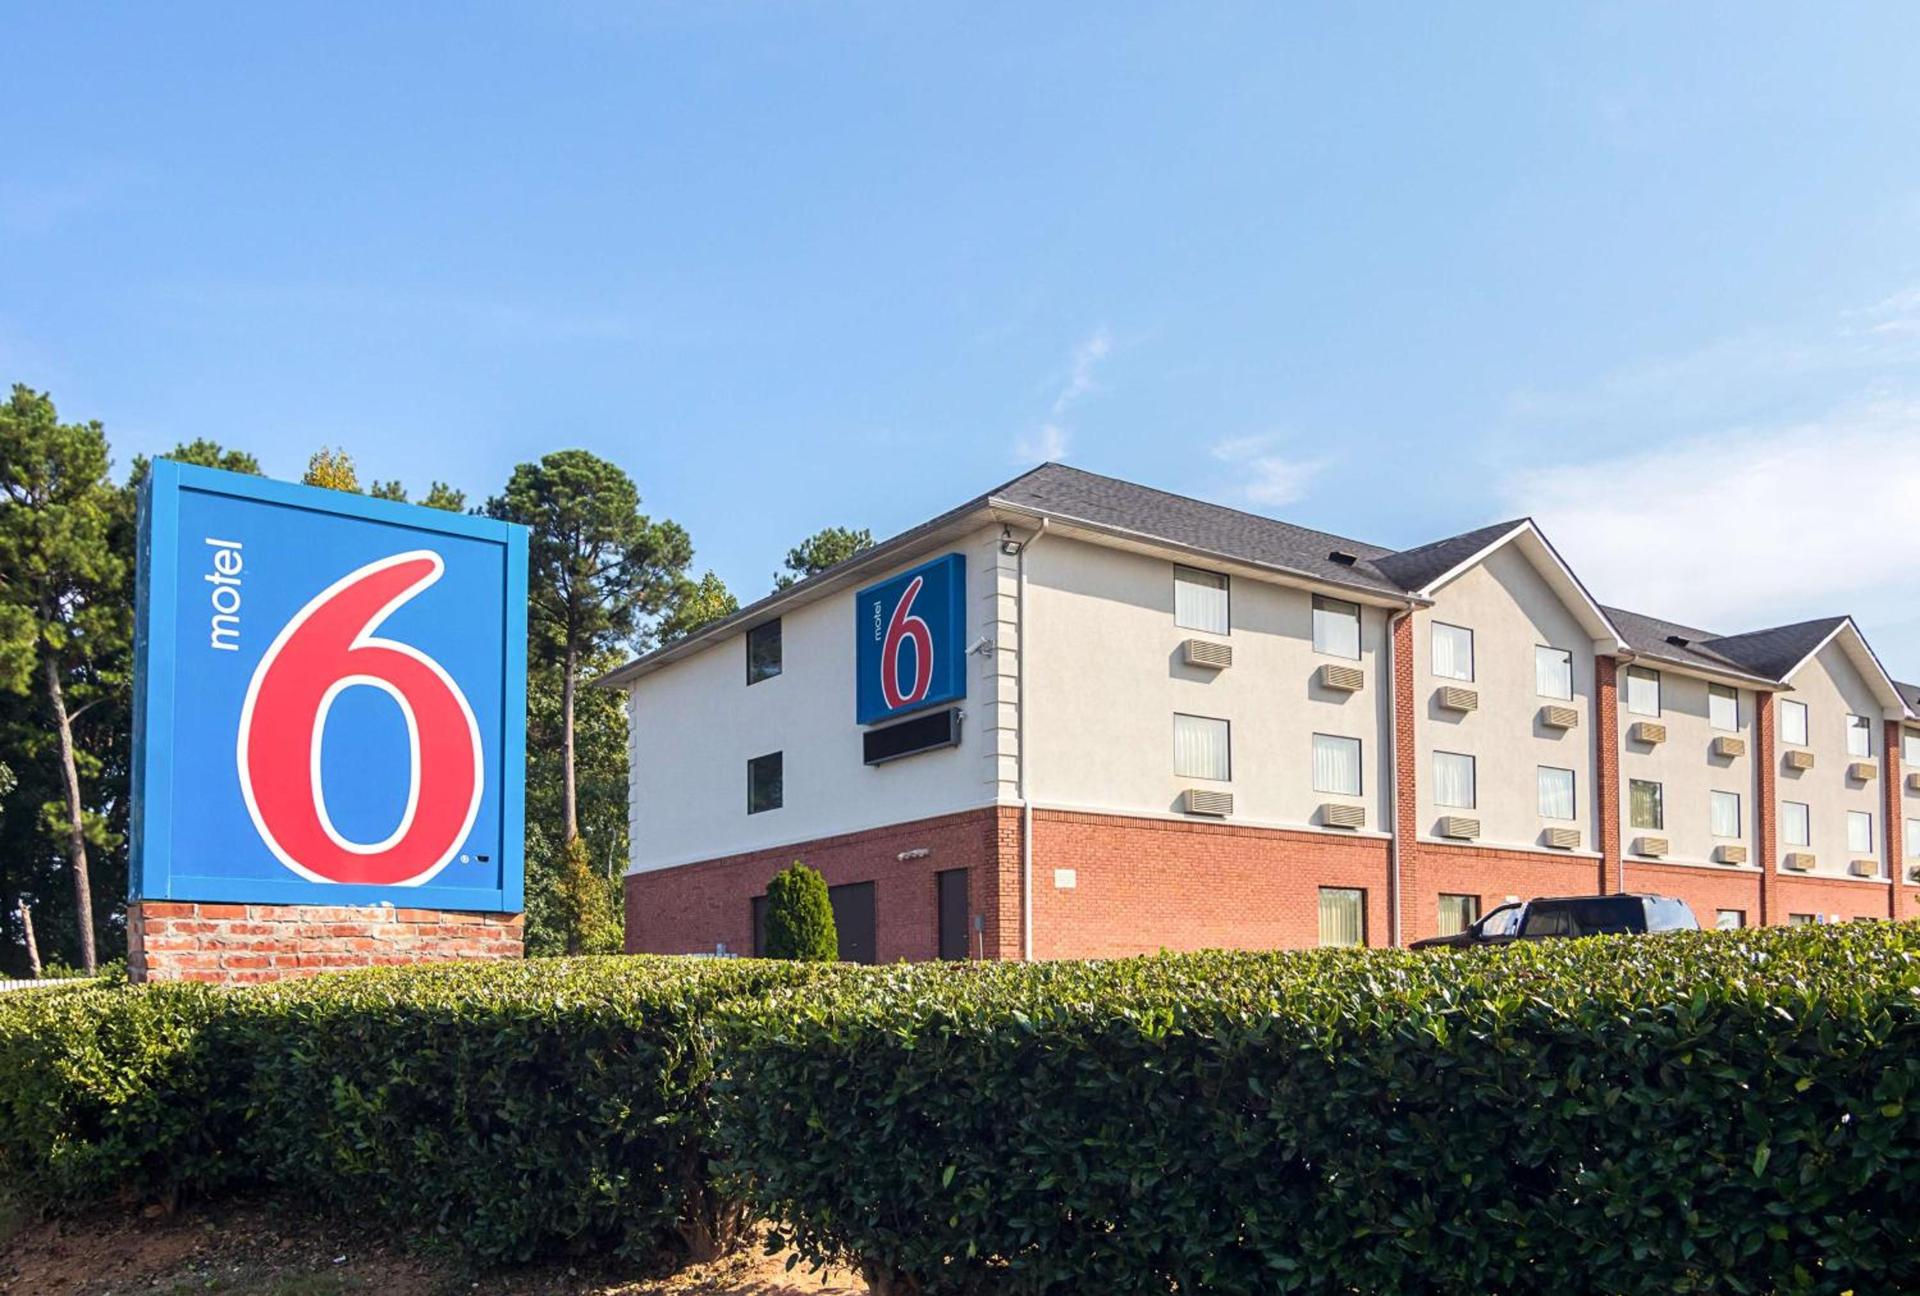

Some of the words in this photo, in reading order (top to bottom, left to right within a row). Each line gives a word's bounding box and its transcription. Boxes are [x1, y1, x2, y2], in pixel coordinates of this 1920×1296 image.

[205, 538, 243, 650] motel
[237, 550, 484, 887] 6
[873, 600, 882, 641] motel
[880, 575, 934, 710] 6
